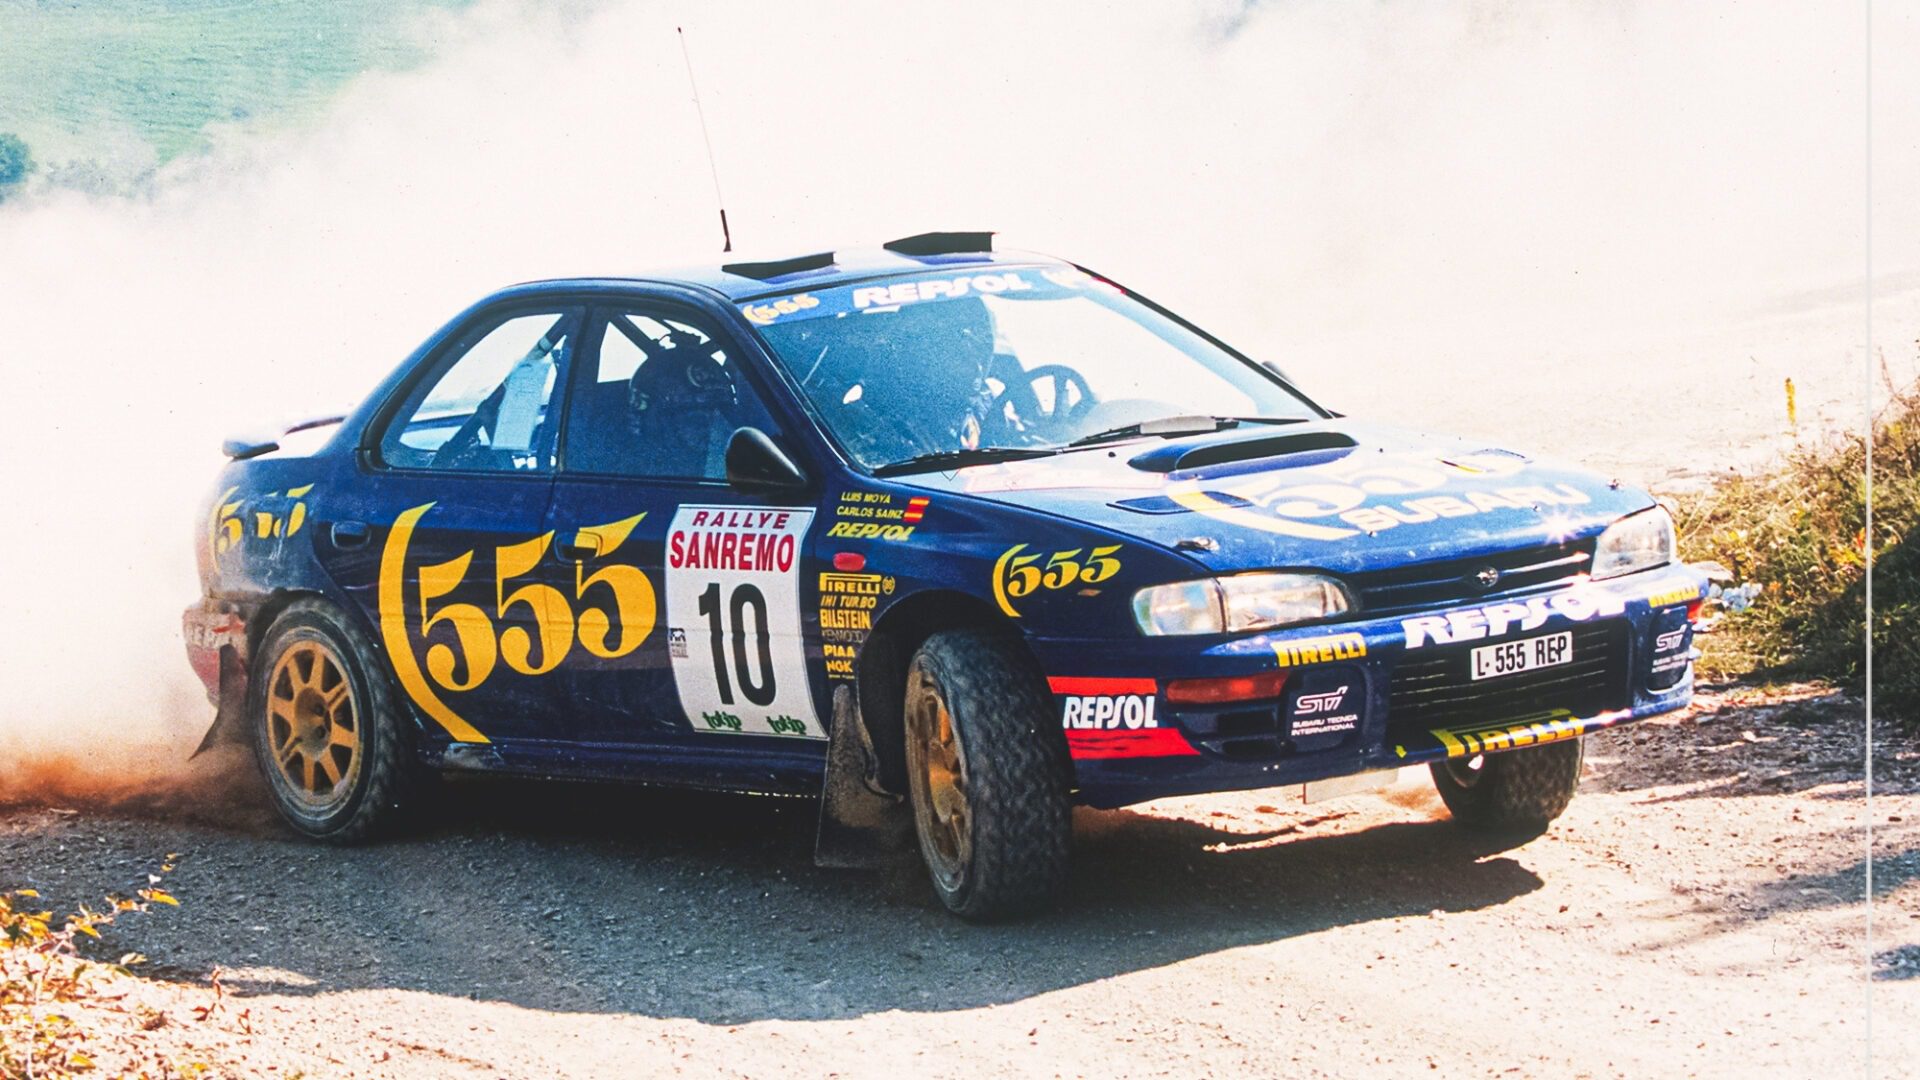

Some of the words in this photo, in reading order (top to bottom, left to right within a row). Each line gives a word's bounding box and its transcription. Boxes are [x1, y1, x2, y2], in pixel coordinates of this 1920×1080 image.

[853, 273, 1032, 309] REPSOL
[841, 491, 862, 502] LUIS
[864, 493, 891, 504] MOYA
[1339, 483, 1591, 533] SUBARU
[692, 511, 790, 529] RALLYE
[836, 505, 874, 517] CARLOS
[875, 508, 904, 519] SAINZ
[826, 521, 916, 542] REPSOL
[670, 530, 794, 573] SANREMO
[819, 572, 882, 594] PIRELLI
[839, 596, 877, 609] TURBO
[819, 608, 871, 629] BILSTEIN
[698, 582, 776, 707] 10
[823, 644, 856, 658] PIAA
[1270, 632, 1367, 667] PIRELLI
[1495, 642, 1527, 673] 555
[1535, 635, 1568, 666] REP
[826, 660, 853, 673] NGK
[1062, 695, 1158, 729] REPSOL
[1292, 718, 1325, 729] SUBARU
[1326, 714, 1358, 725] TECNICA
[1291, 722, 1355, 736] INTERNATIONAL
[1430, 708, 1585, 758] PIRELLI
